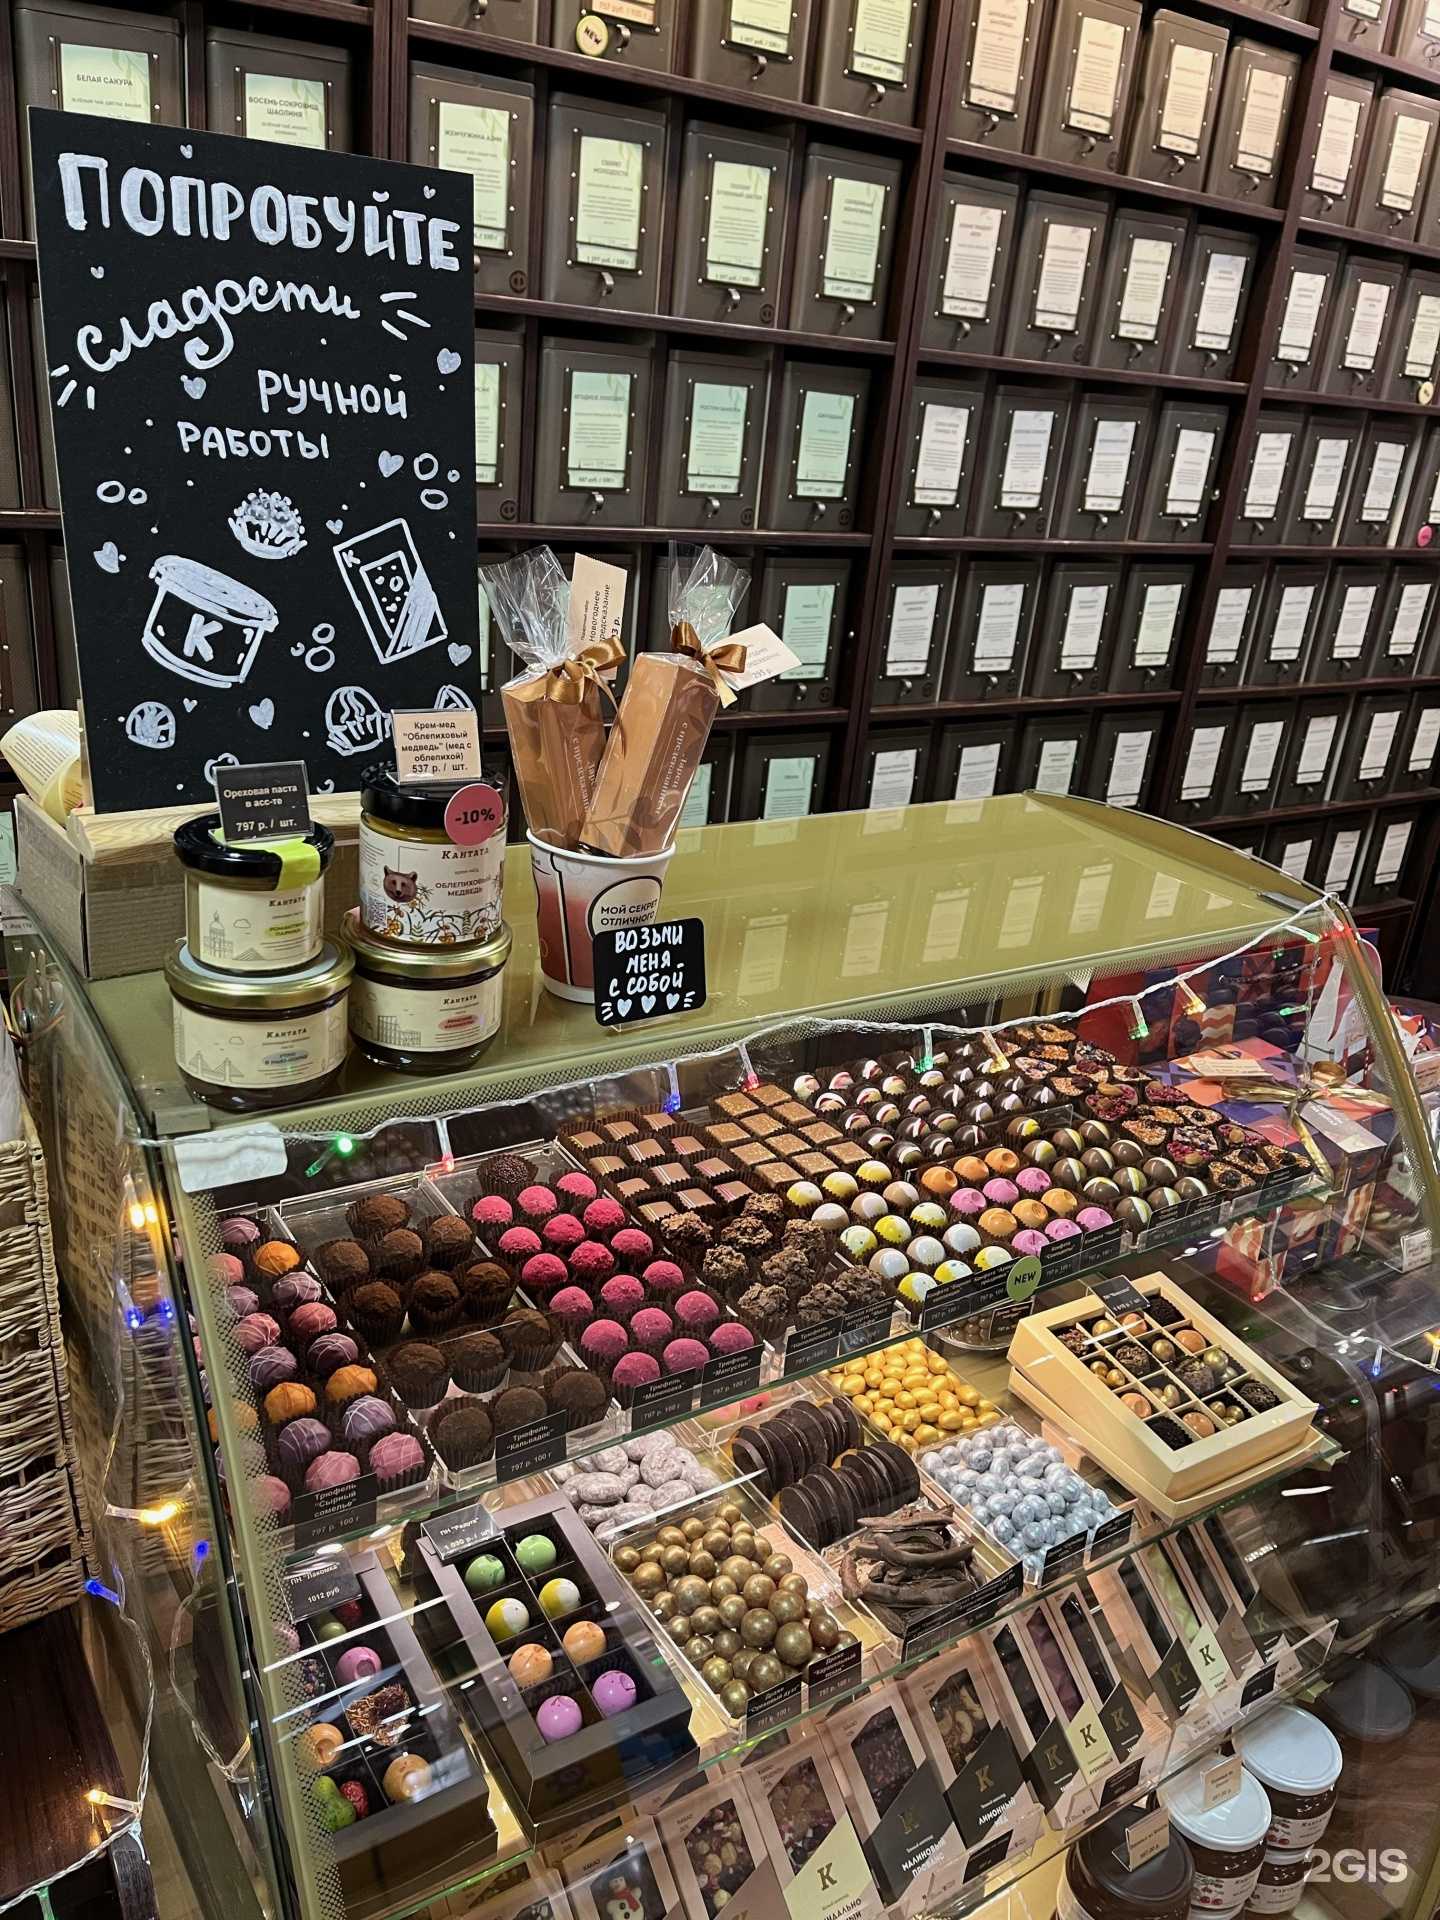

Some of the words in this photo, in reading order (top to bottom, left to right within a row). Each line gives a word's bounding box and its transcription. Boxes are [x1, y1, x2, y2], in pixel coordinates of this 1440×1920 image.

[76, 73, 102, 83] БЕЛАЯ
[103, 76, 133, 87] САКУРА
[248, 96, 279, 106] ВОСЕМЬ
[57, 151, 461, 272] ПОПРОБУЙТЕ
[257, 368, 408, 420] РУЧНОЙ
[176, 420, 330, 460] РАБОТЫ
[589, 590, 601, 642] Новогоднее
[414, 721, 456, 731] Крем-мед
[403, 730, 469, 741] "Облепиховый
[401, 742, 444, 752] медведь"
[445, 742, 465, 751] (мед
[414, 752, 465, 762] облепихой)
[412, 764, 429, 774] 537
[432, 764, 441, 774] р.
[452, 763, 469, 771] шт.
[223, 787, 270, 799] Ореховая
[271, 785, 298, 794] паста
[254, 798, 283, 807] асс-те
[455, 807, 496, 825] -10%
[235, 821, 255, 832] 797
[258, 822, 268, 832] р.
[279, 819, 297, 827] шт.
[447, 886, 484, 897] МЕДВЕДЬ
[600, 904, 627, 915] МОЙ
[628, 898, 658, 914] СЕКРЕТ
[600, 910, 655, 926] ОТЛИЧНОГО
[614, 924, 684, 954] ВОЗЬМИ
[625, 950, 672, 975] МЕНЯ
[626, 962, 685, 996] СОБОЙ
[1013, 1270, 1037, 1286] NEW
[512, 1425, 549, 1441] Трюфель
[534, 1453, 547, 1462] 100
[314, 1483, 357, 1501] Трюфель
[314, 1490, 357, 1508] "Сырный
[340, 1517, 354, 1527] 100
[290, 1577, 303, 1586] ПН
[307, 1592, 327, 1604] 1012
[326, 1586, 341, 1598] руб
[977, 1796, 1017, 1826] ЛИМОННЫЙ
[901, 1837, 948, 1873] МАЛИНОВЫЙ
[824, 1897, 862, 1920] НДАЛЬНО
